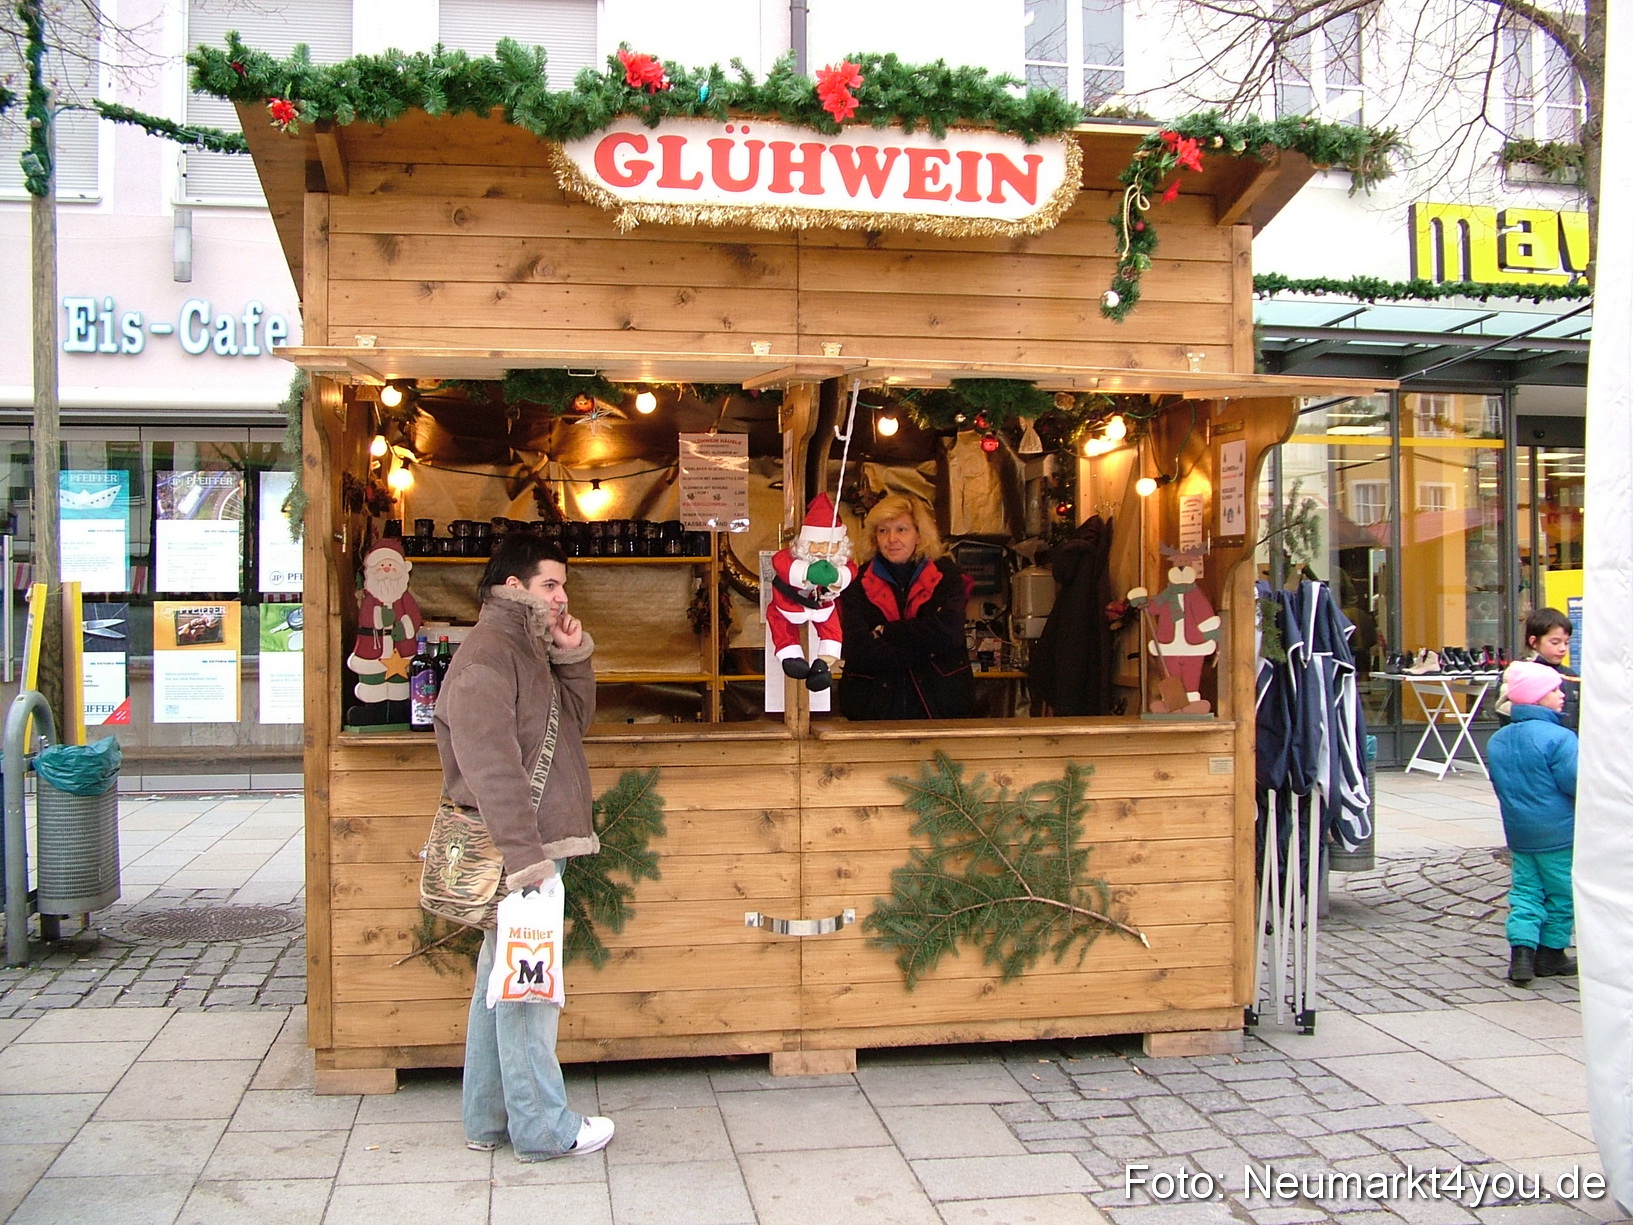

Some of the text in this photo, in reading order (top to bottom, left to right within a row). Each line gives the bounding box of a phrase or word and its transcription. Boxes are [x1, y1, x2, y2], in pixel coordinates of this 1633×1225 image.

[593, 124, 1044, 206] GLÜHWEIN
[62, 296, 289, 357] Eis-Cafe
[70, 473, 118, 483] PFEIFFER
[186, 477, 234, 486] PFEIFFER
[272, 574, 282, 582] JP
[180, 605, 227, 614] PFEIFFER
[508, 927, 554, 941] Müller
[517, 959, 545, 985] M
